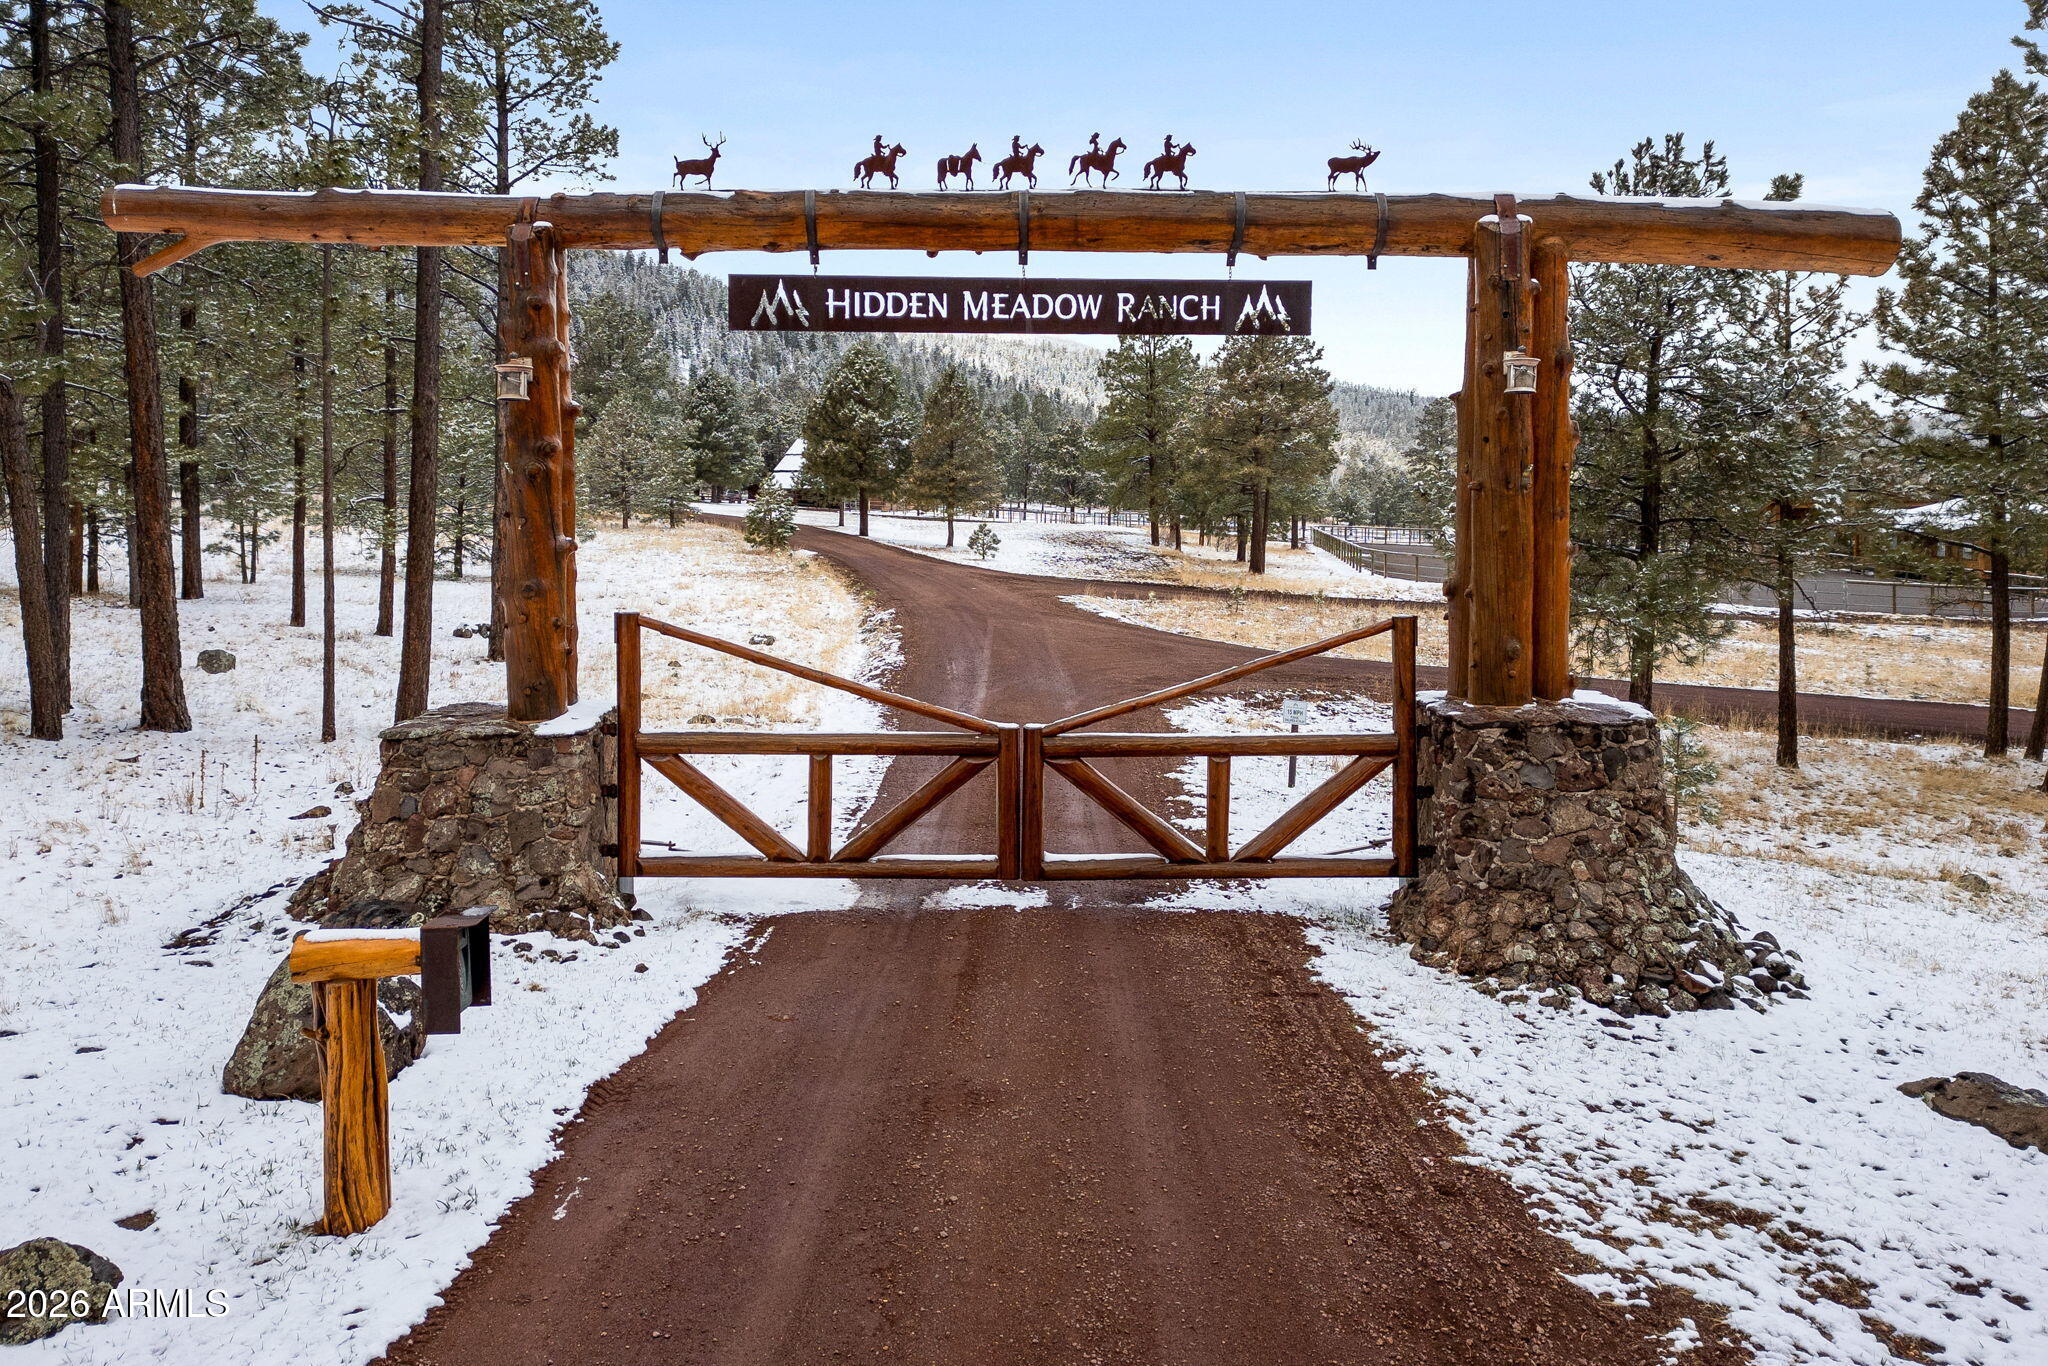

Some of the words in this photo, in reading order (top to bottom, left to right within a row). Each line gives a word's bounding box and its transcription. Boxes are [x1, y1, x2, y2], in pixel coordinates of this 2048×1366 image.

[825, 288, 948, 319] HIDDEN
[962, 291, 1103, 321] MEADOW
[1117, 293, 1221, 322] RANCH
